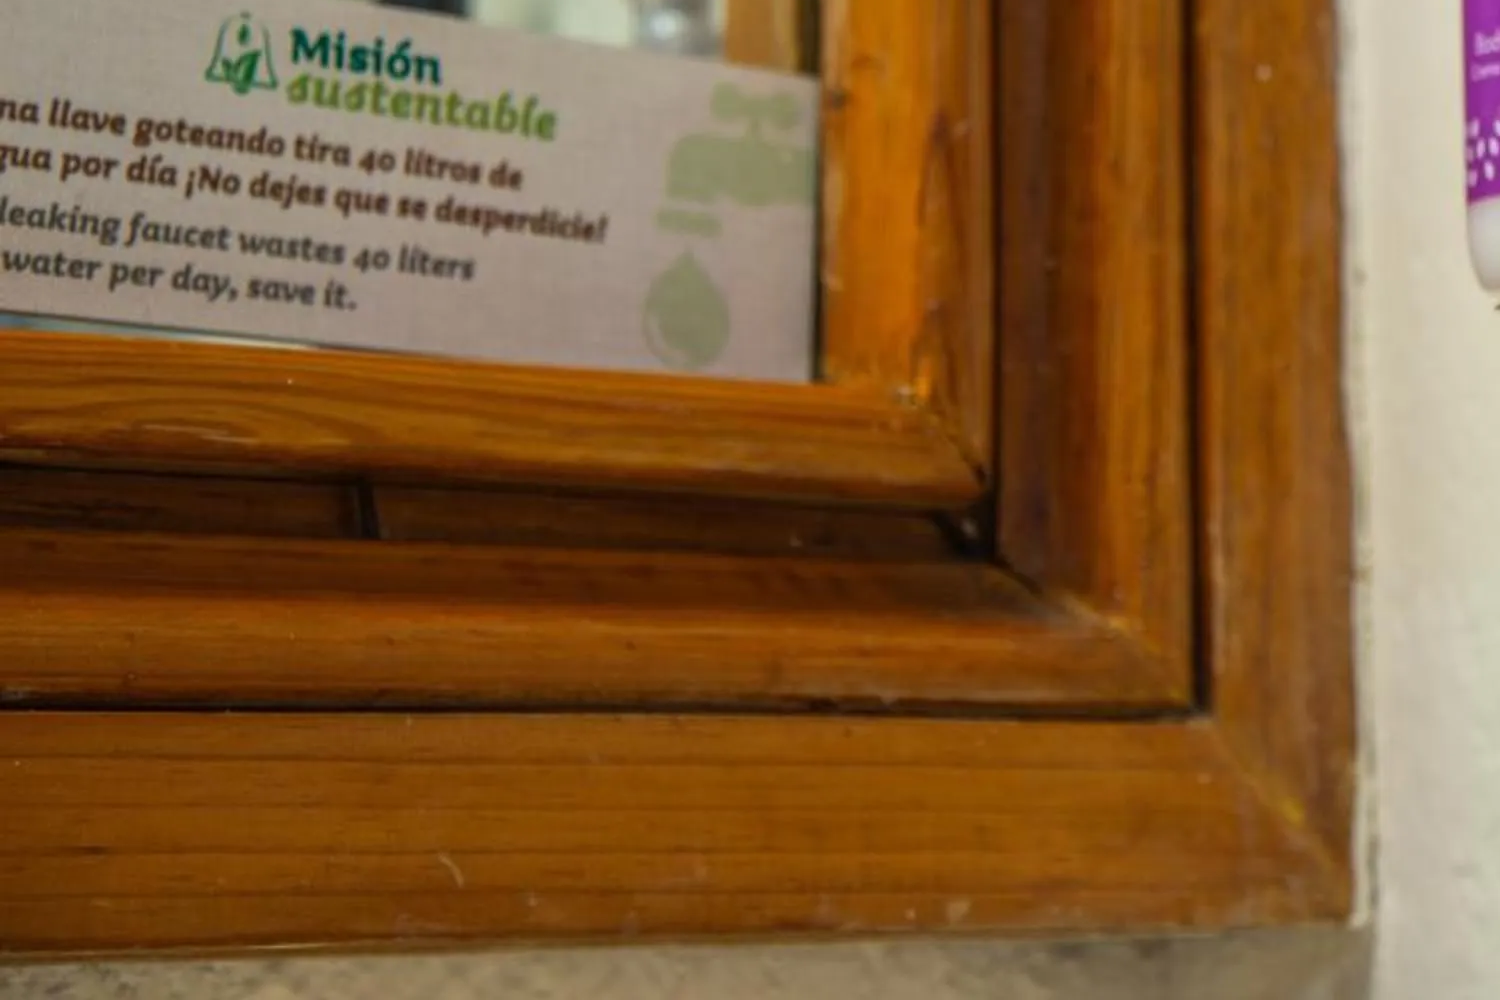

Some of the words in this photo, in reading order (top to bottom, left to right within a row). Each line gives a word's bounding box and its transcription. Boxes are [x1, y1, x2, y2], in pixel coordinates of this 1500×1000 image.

[290, 26, 443, 86] Misión
[287, 72, 557, 142] sustentable
[48, 96, 126, 135] llave
[132, 116, 286, 158] goteando
[294, 134, 351, 167] tira
[357, 150, 396, 176] 40
[404, 147, 481, 185] litros
[488, 157, 524, 190] de
[59, 152, 118, 183] por
[125, 153, 177, 187] día
[248, 170, 328, 211] dejes
[333, 187, 390, 219] que
[397, 196, 428, 222] se
[434, 195, 609, 245] desperdicie!
[1, 249, 102, 281] water
[107, 261, 164, 293] per
[171, 263, 238, 303] day,
[247, 277, 317, 306] save
[323, 279, 357, 311] it.
[124, 211, 230, 251] faucet
[238, 231, 346, 266] wastes
[353, 248, 392, 273] 40
[397, 242, 476, 282] liters
